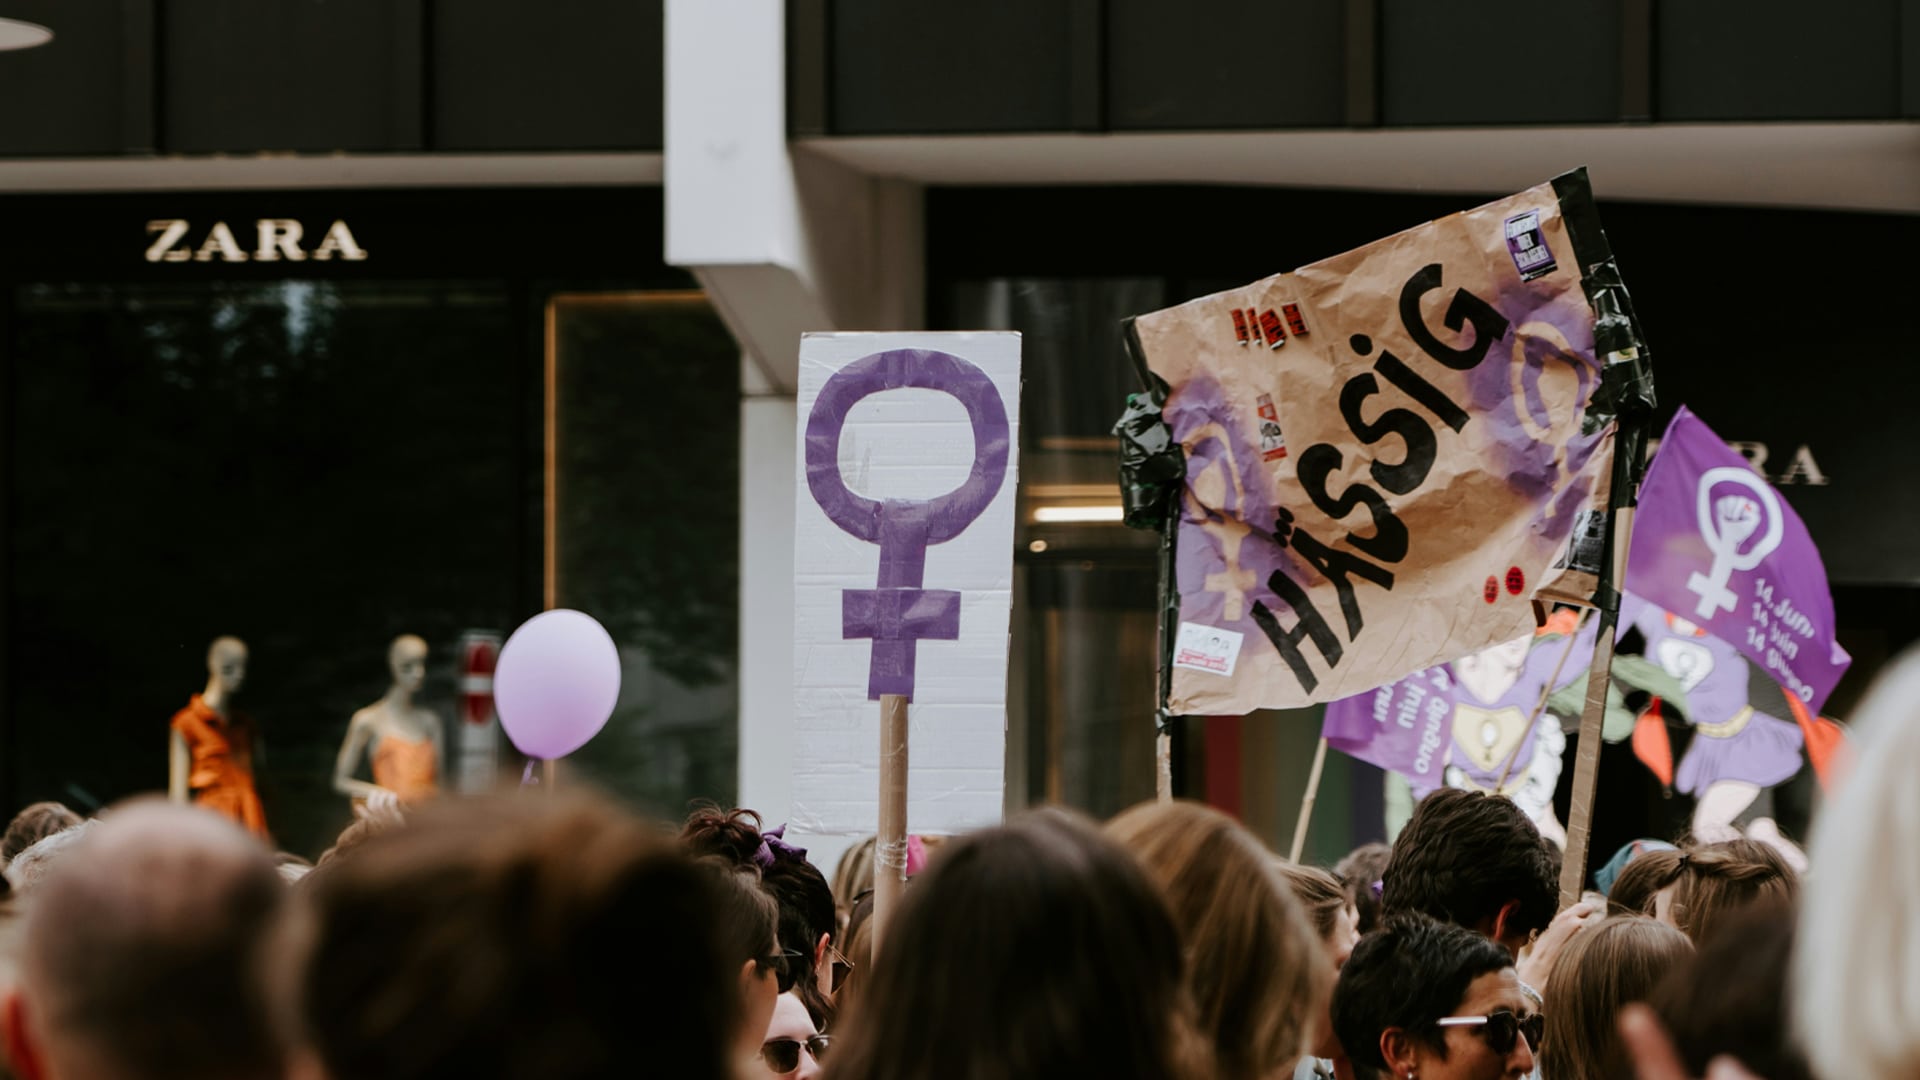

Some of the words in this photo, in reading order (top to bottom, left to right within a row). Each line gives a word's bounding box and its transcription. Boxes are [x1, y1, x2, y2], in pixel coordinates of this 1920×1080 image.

[145, 219, 368, 262] ZARA
[1752, 602, 1769, 628] 14
[1747, 626, 1766, 653] 14
[1766, 647, 1814, 703] giuo
